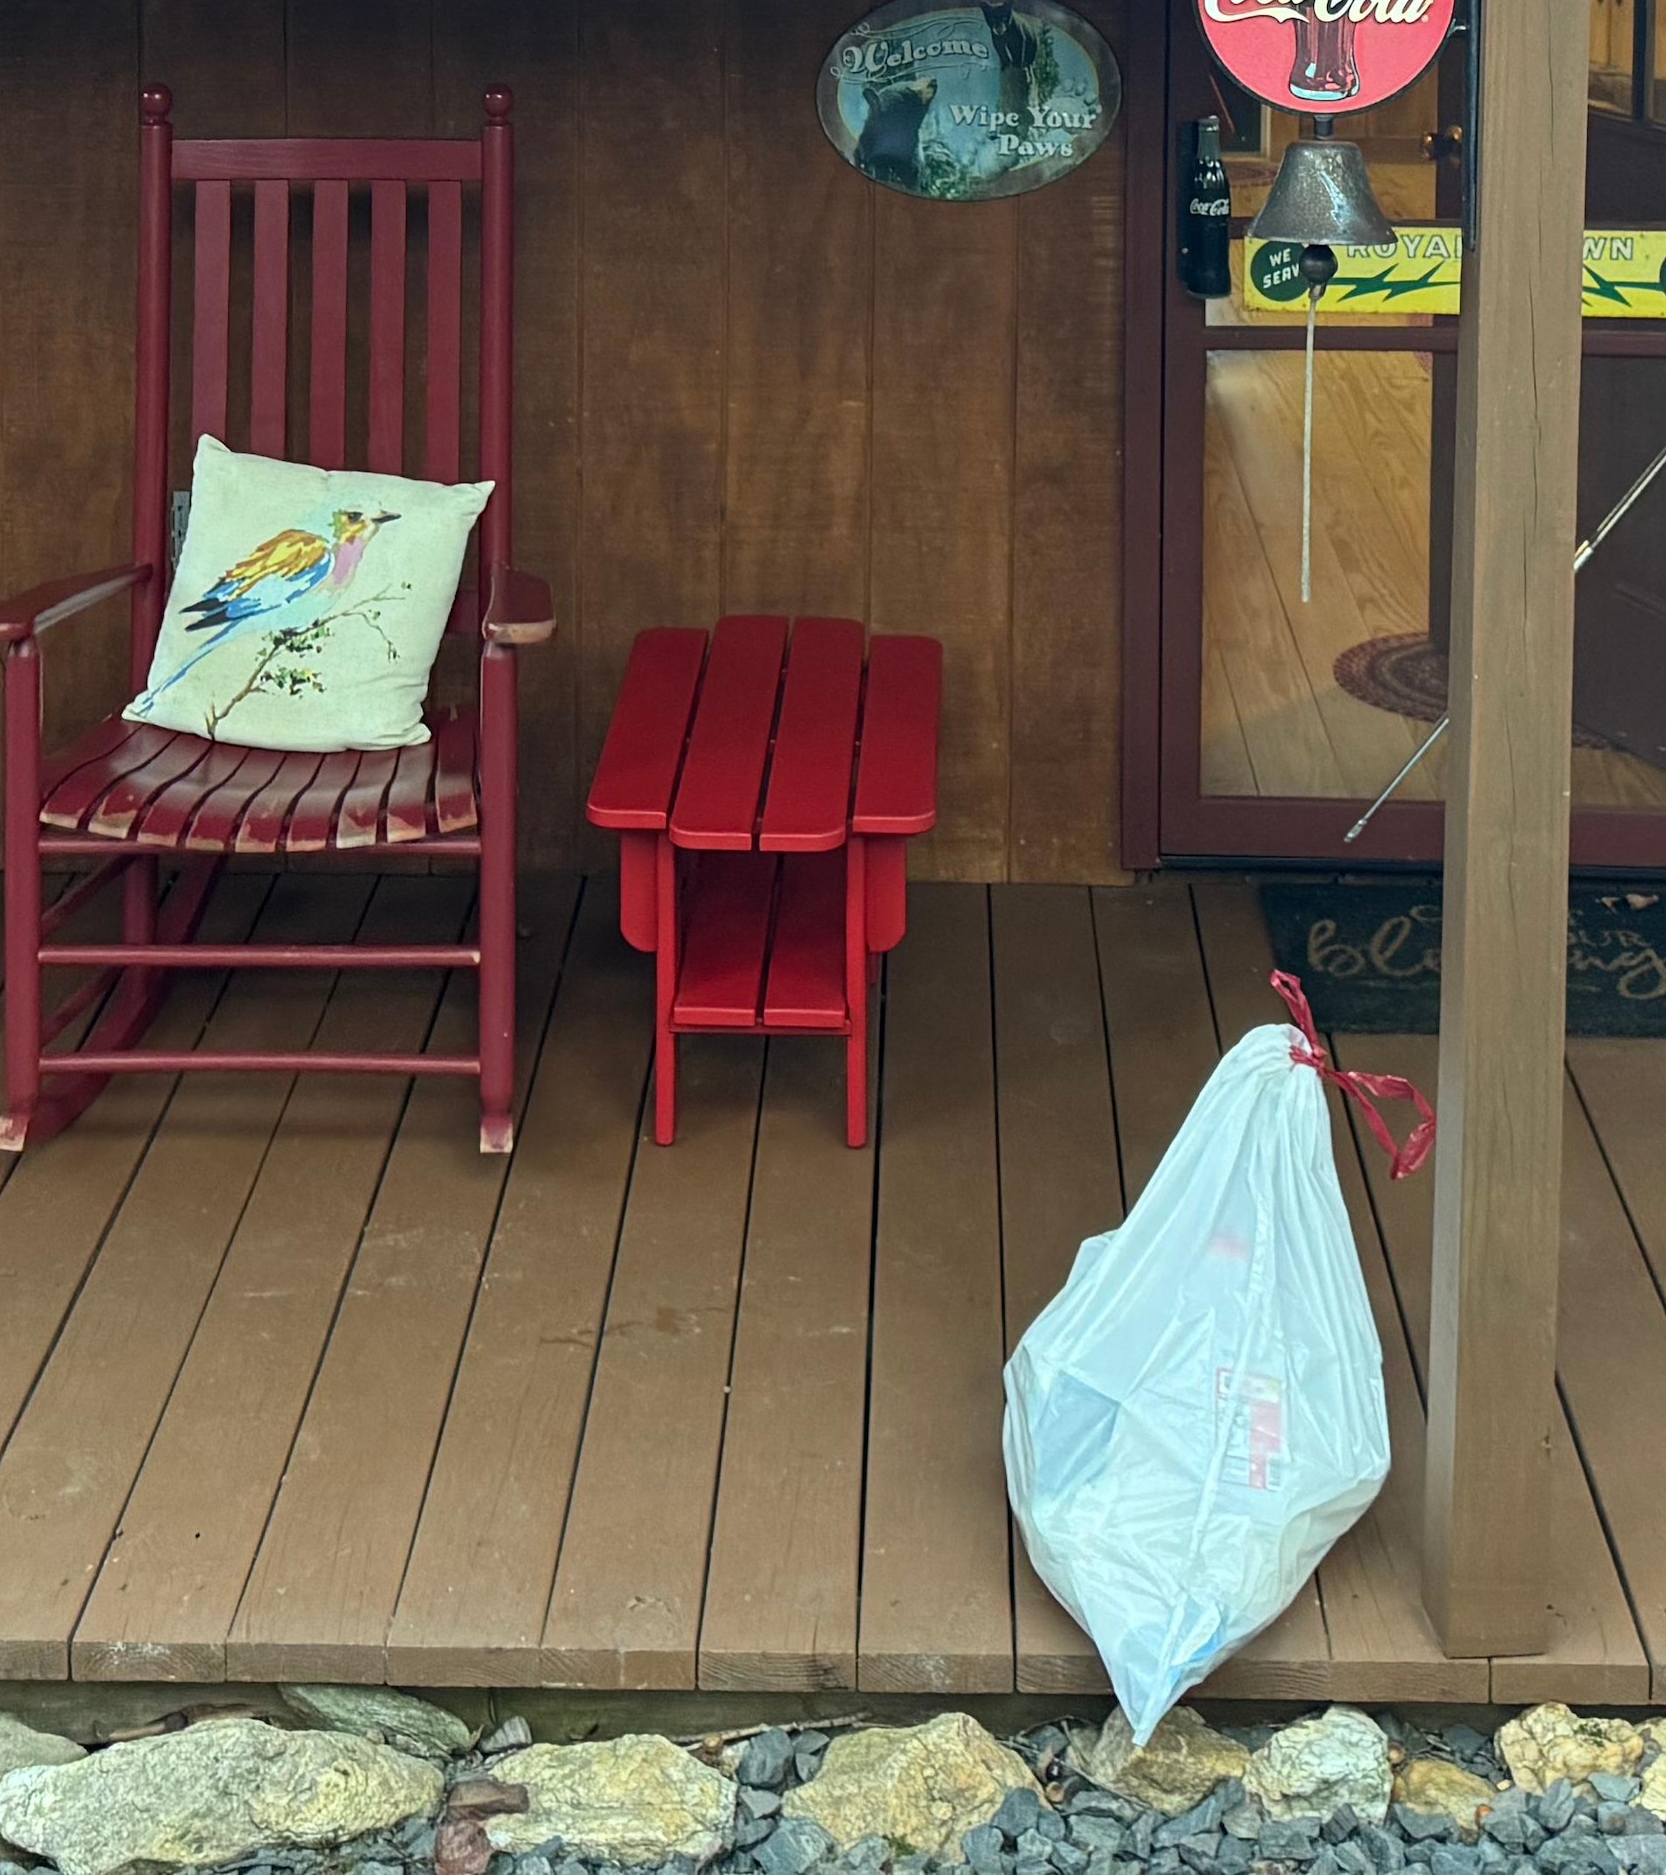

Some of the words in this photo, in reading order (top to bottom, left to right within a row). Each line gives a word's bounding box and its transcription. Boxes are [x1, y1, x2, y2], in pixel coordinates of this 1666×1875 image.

[843, 39, 989, 73] Welcome
[949, 104, 1020, 131] Wipe
[1027, 106, 1097, 130] Your
[997, 133, 1074, 157] Paws
[1269, 248, 1292, 268] WE
[1262, 263, 1300, 290] SERV
